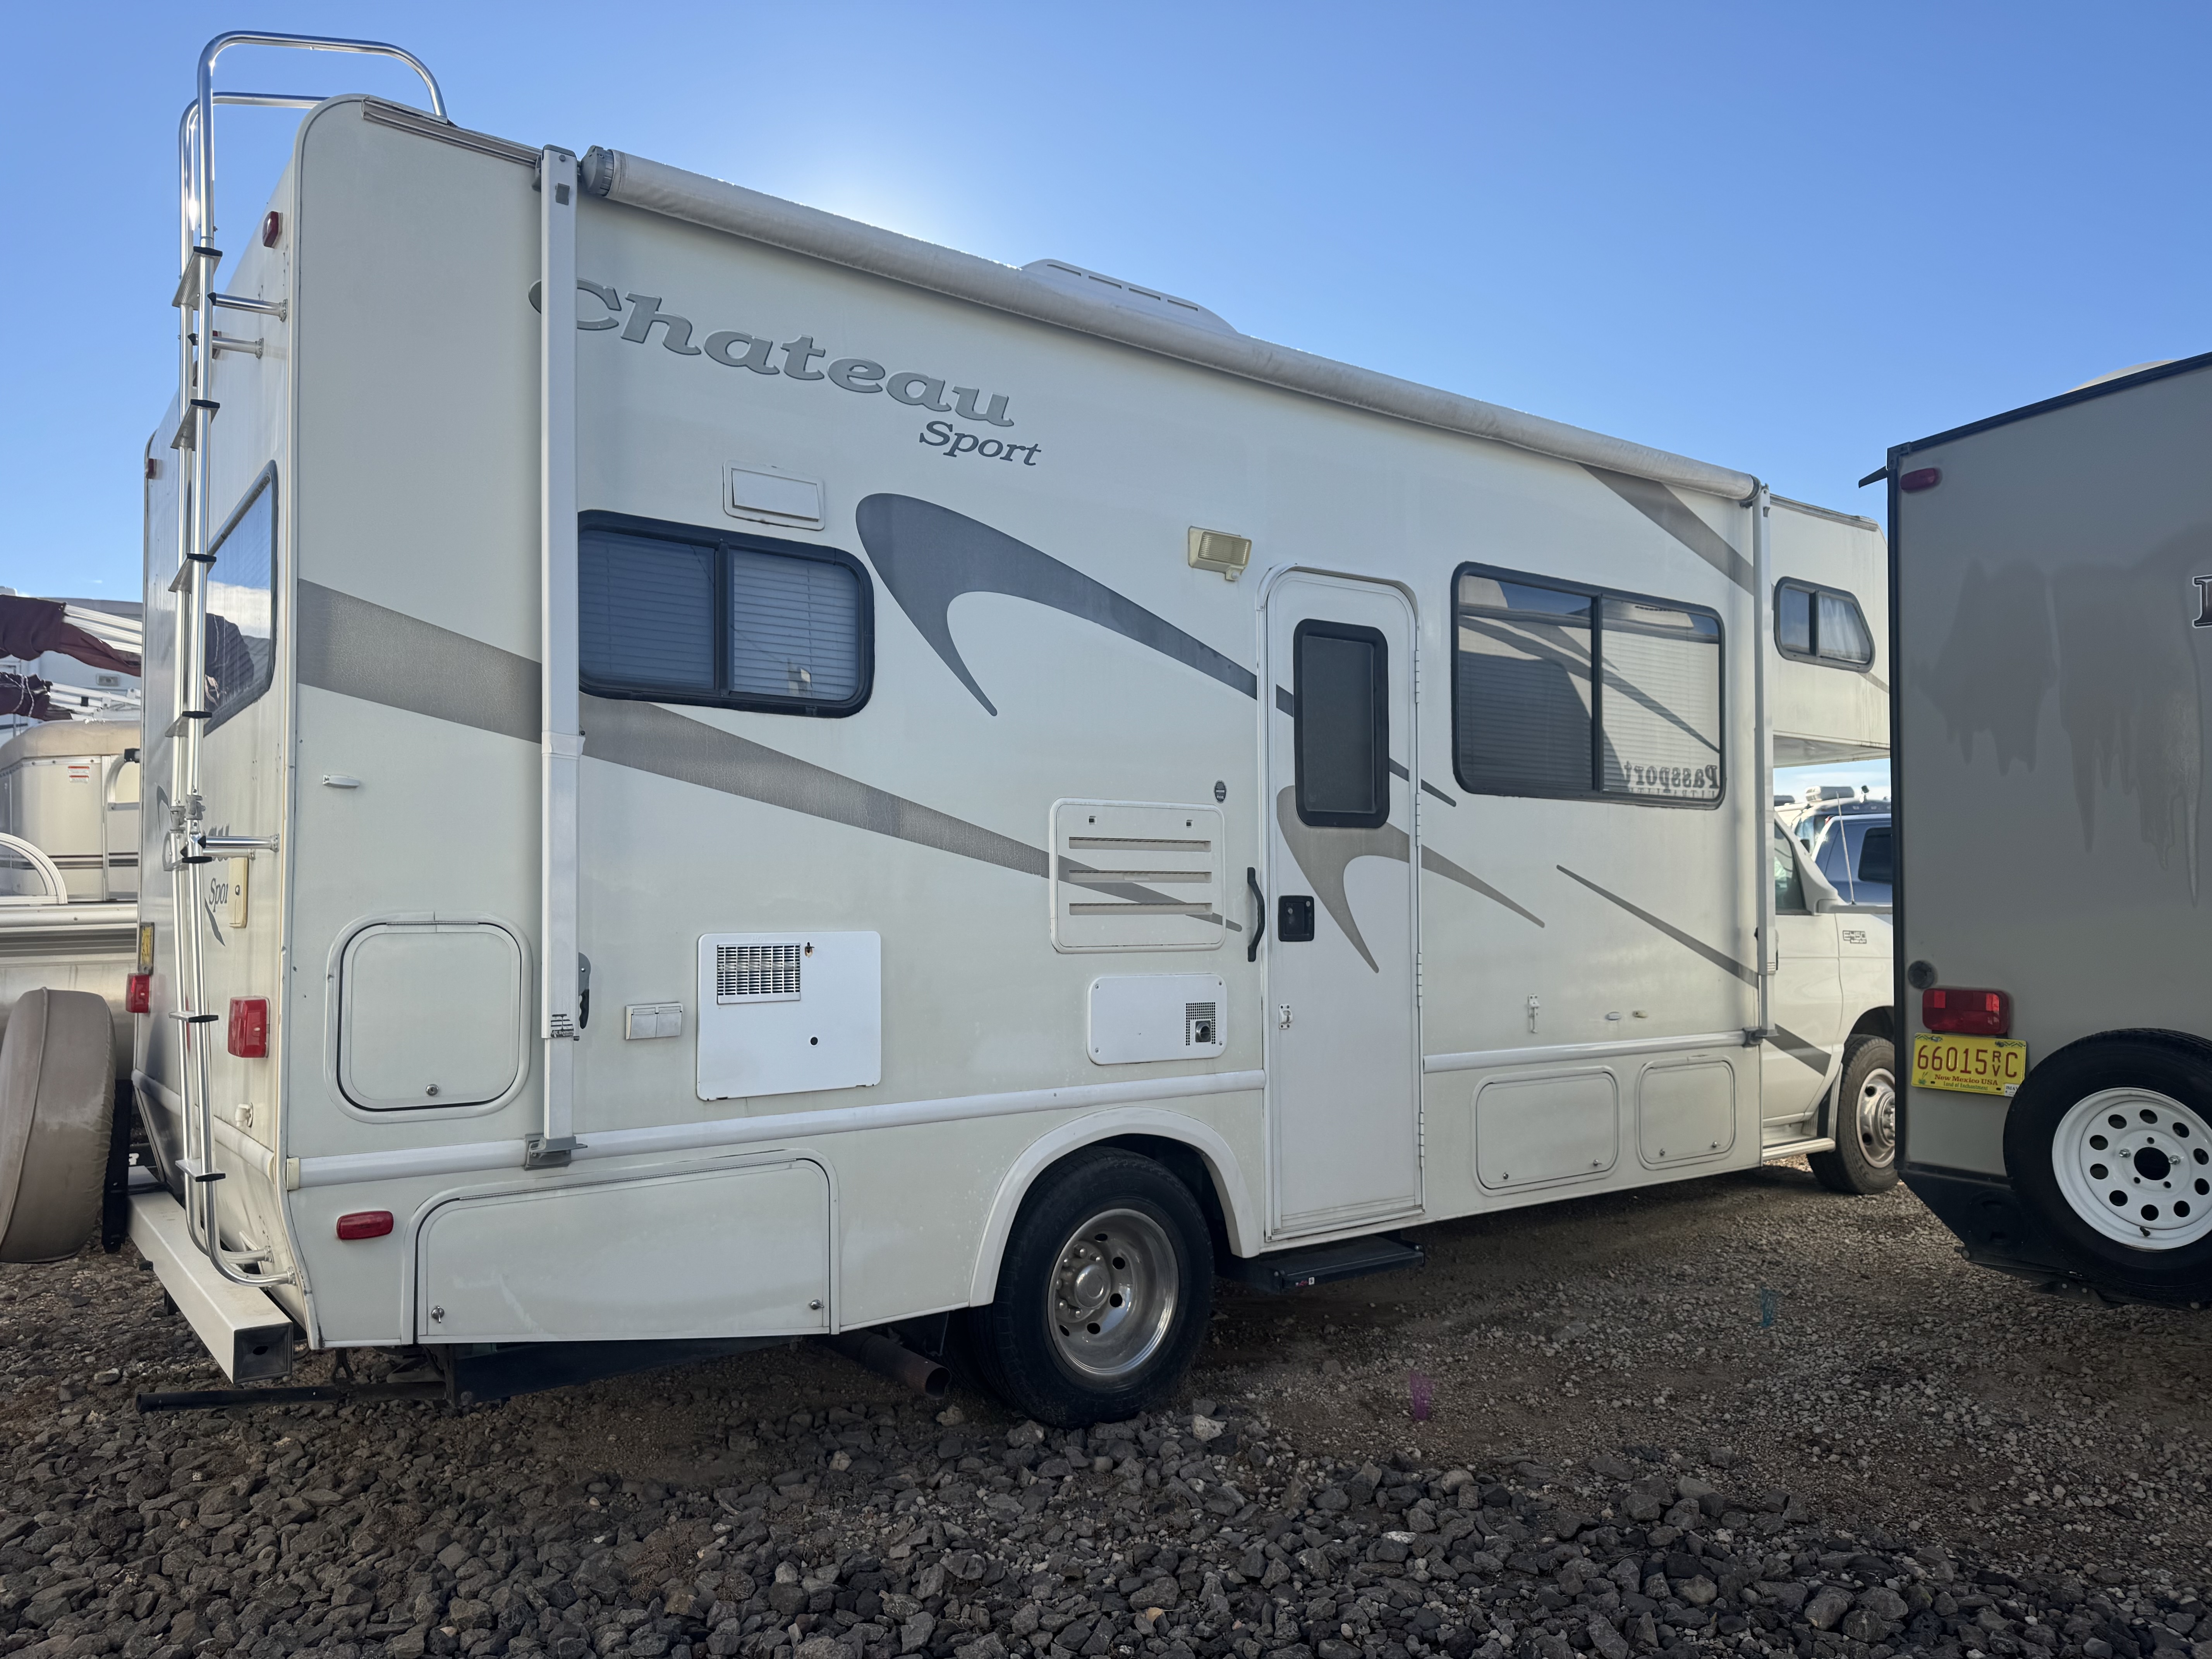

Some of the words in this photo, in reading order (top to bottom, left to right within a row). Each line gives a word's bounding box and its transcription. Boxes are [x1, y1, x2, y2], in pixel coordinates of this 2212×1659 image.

[528, 277, 1015, 427] Chateau
[919, 421, 1042, 466] Sport
[1952, 1075, 1980, 1084] Mexico
